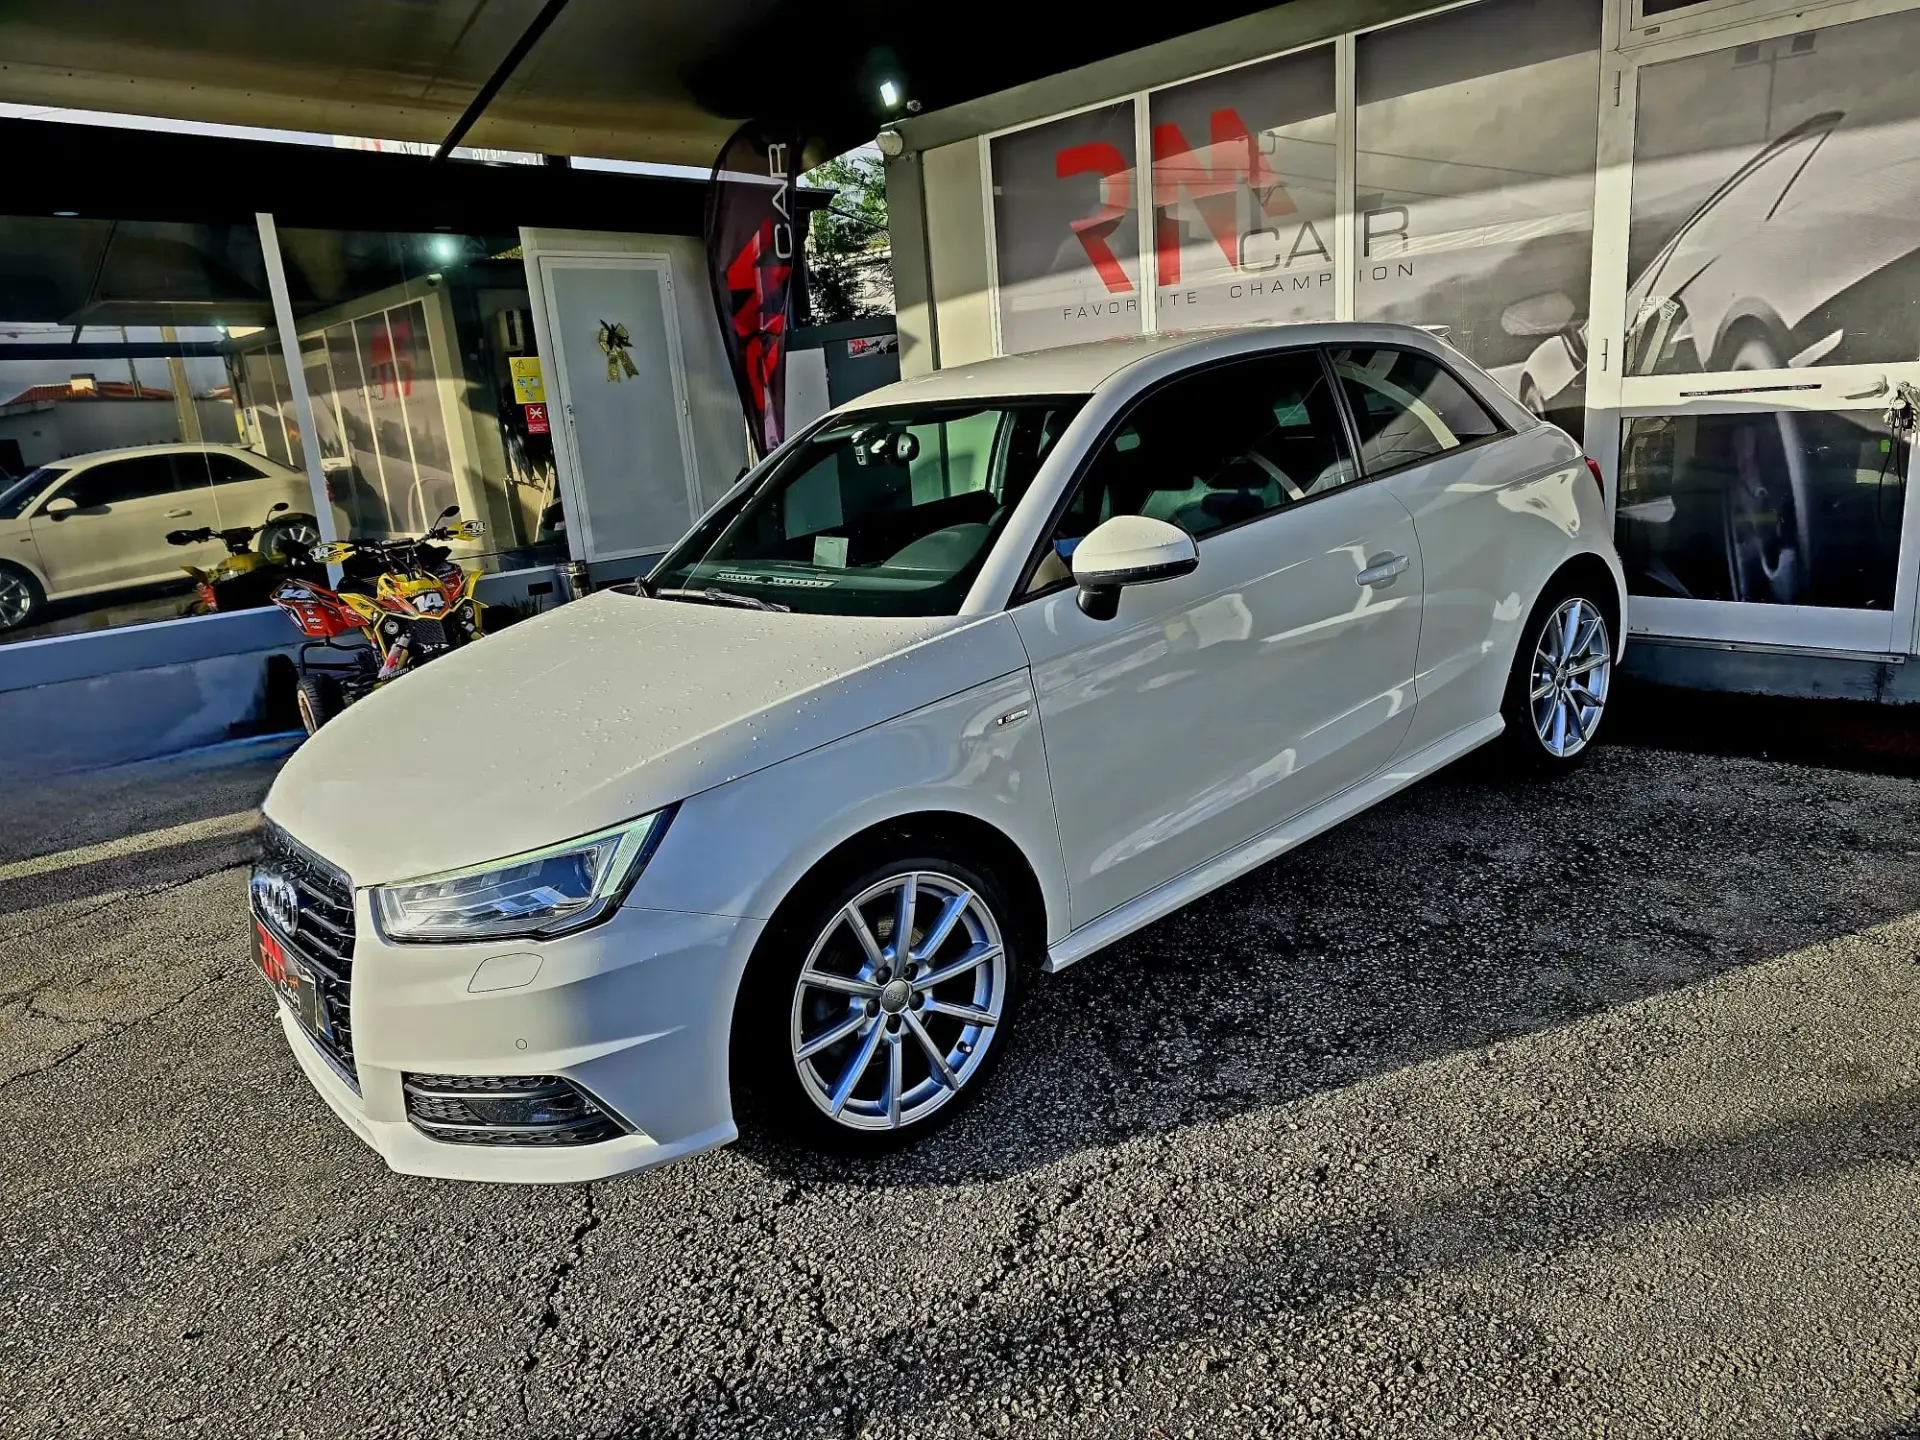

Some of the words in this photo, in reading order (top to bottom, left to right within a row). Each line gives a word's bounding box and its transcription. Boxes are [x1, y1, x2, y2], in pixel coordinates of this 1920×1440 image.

[768, 143, 793, 259] CAR
[1238, 205, 1410, 274] CAR
[1063, 290, 1198, 321] FAVORITE
[1229, 262, 1414, 300] CHAMPION
[412, 592, 445, 613] 14
[280, 978, 301, 1011] CAR
